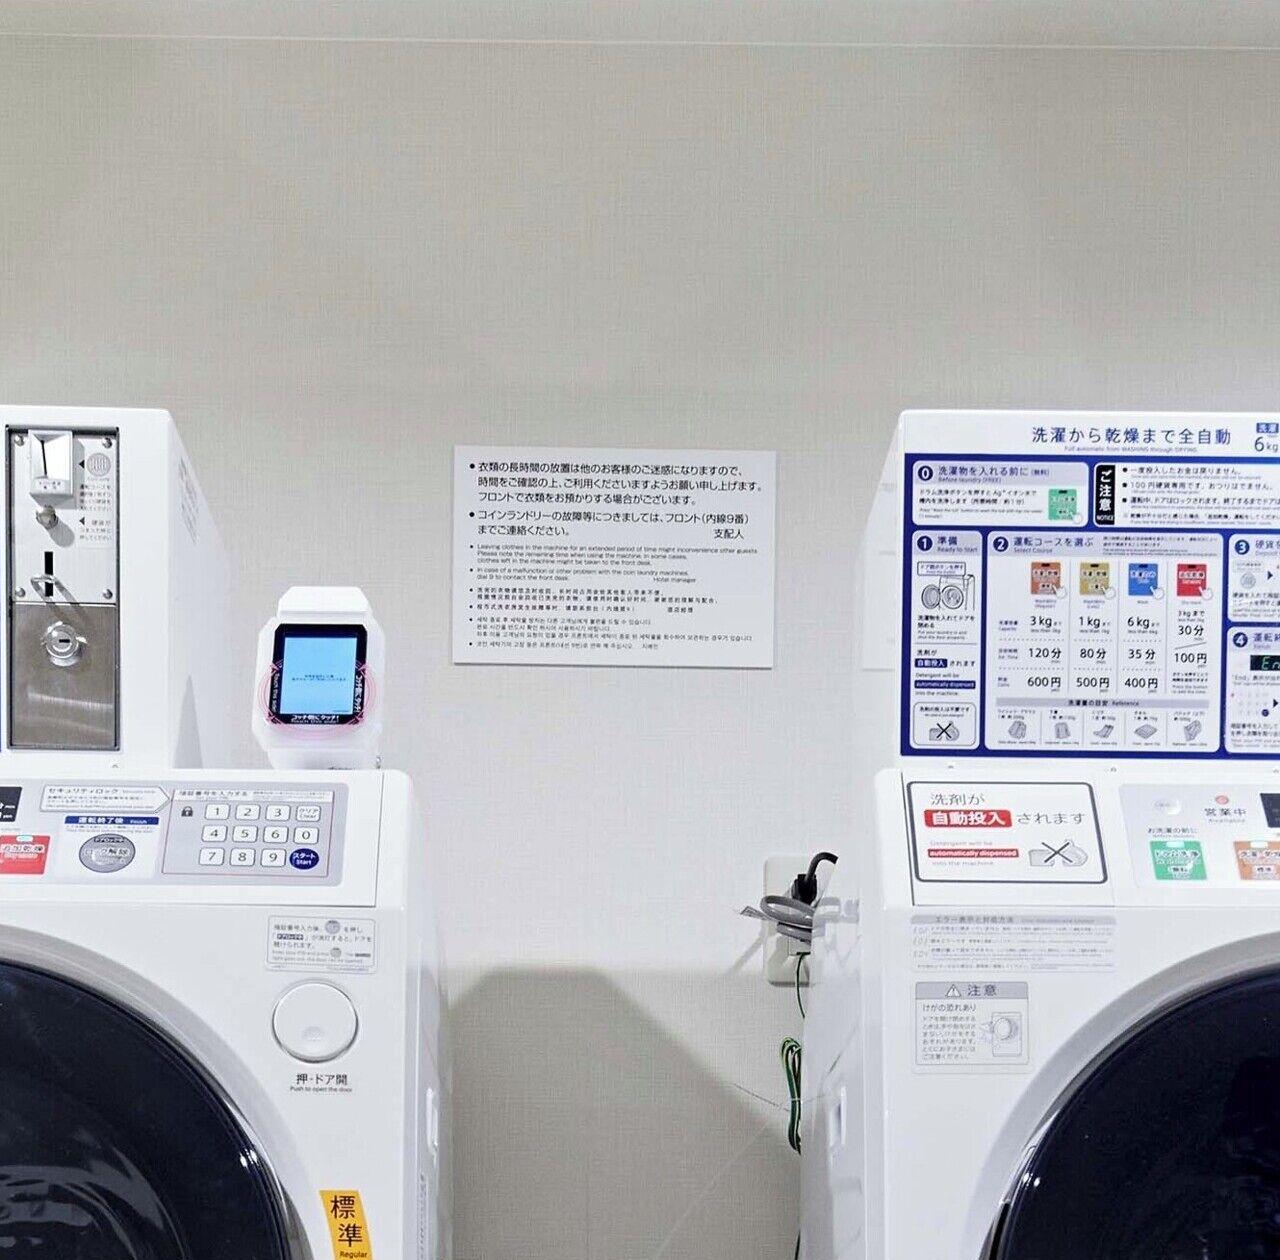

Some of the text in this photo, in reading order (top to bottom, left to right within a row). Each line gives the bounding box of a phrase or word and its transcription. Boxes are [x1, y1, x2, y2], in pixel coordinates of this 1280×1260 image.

[1031, 426, 1232, 444] 洗濯から乾燥まで全自動
[478, 461, 743, 477] 衣類の長時間の放置は他のお客様のご迷惑になりますので、
[477, 476, 762, 492] 時間をご確認の上、ご利用くださいますようお願い申し上げます。
[1099, 469, 1113, 512] ご注意
[477, 492, 697, 506] フロントで衣類をお預かりする場合がございます。
[477, 524, 570, 537] までご連絡ください。
[713, 528, 744, 540] 支配人
[1013, 536, 1094, 548] 運転コースを選ぶ
[929, 793, 985, 806] 洗剤が
[932, 811, 1086, 825] 自動投入 されます
[929, 849, 1017, 858] automatically dispensed
[967, 984, 997, 997] 注意
[312, 1086, 327, 1094] open
[330, 1195, 363, 1248] 標準
[339, 1250, 368, 1260] Regular
